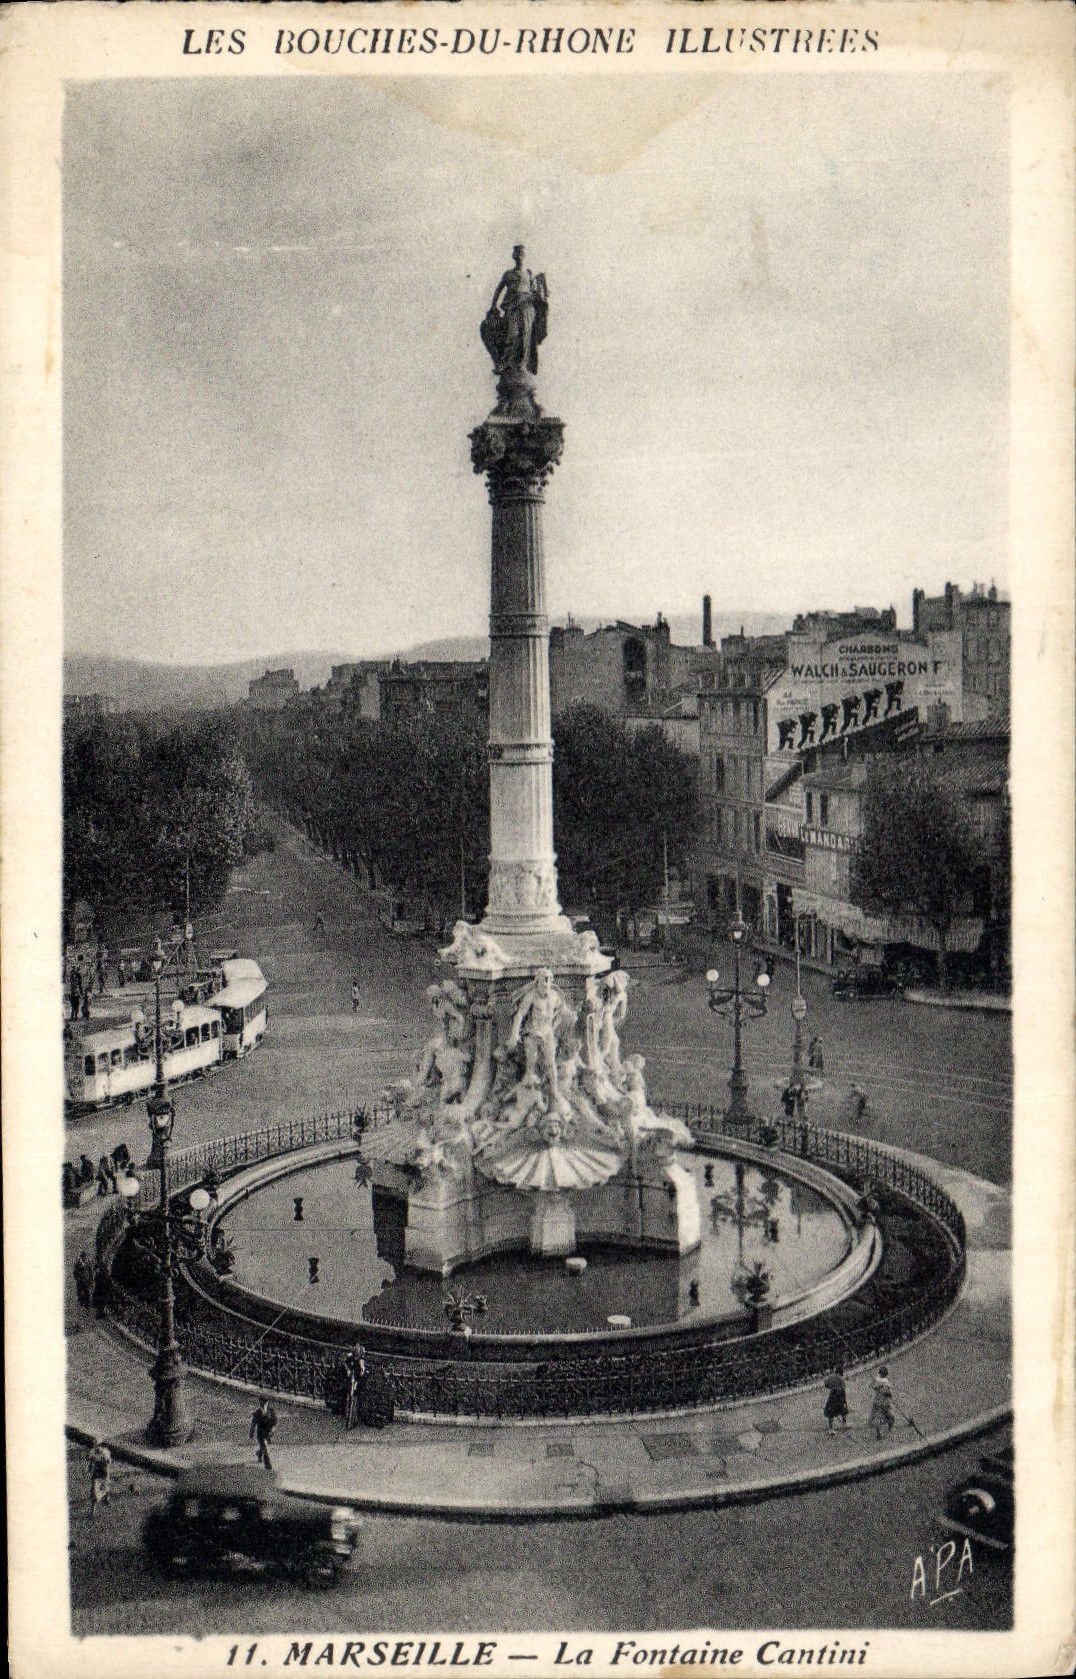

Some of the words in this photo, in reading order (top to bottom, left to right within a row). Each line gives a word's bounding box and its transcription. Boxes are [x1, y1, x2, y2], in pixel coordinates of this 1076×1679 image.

[838, 645, 899, 655] CHARBONS
[791, 662, 839, 678] WALCH
[849, 661, 929, 677] SAUGERON
